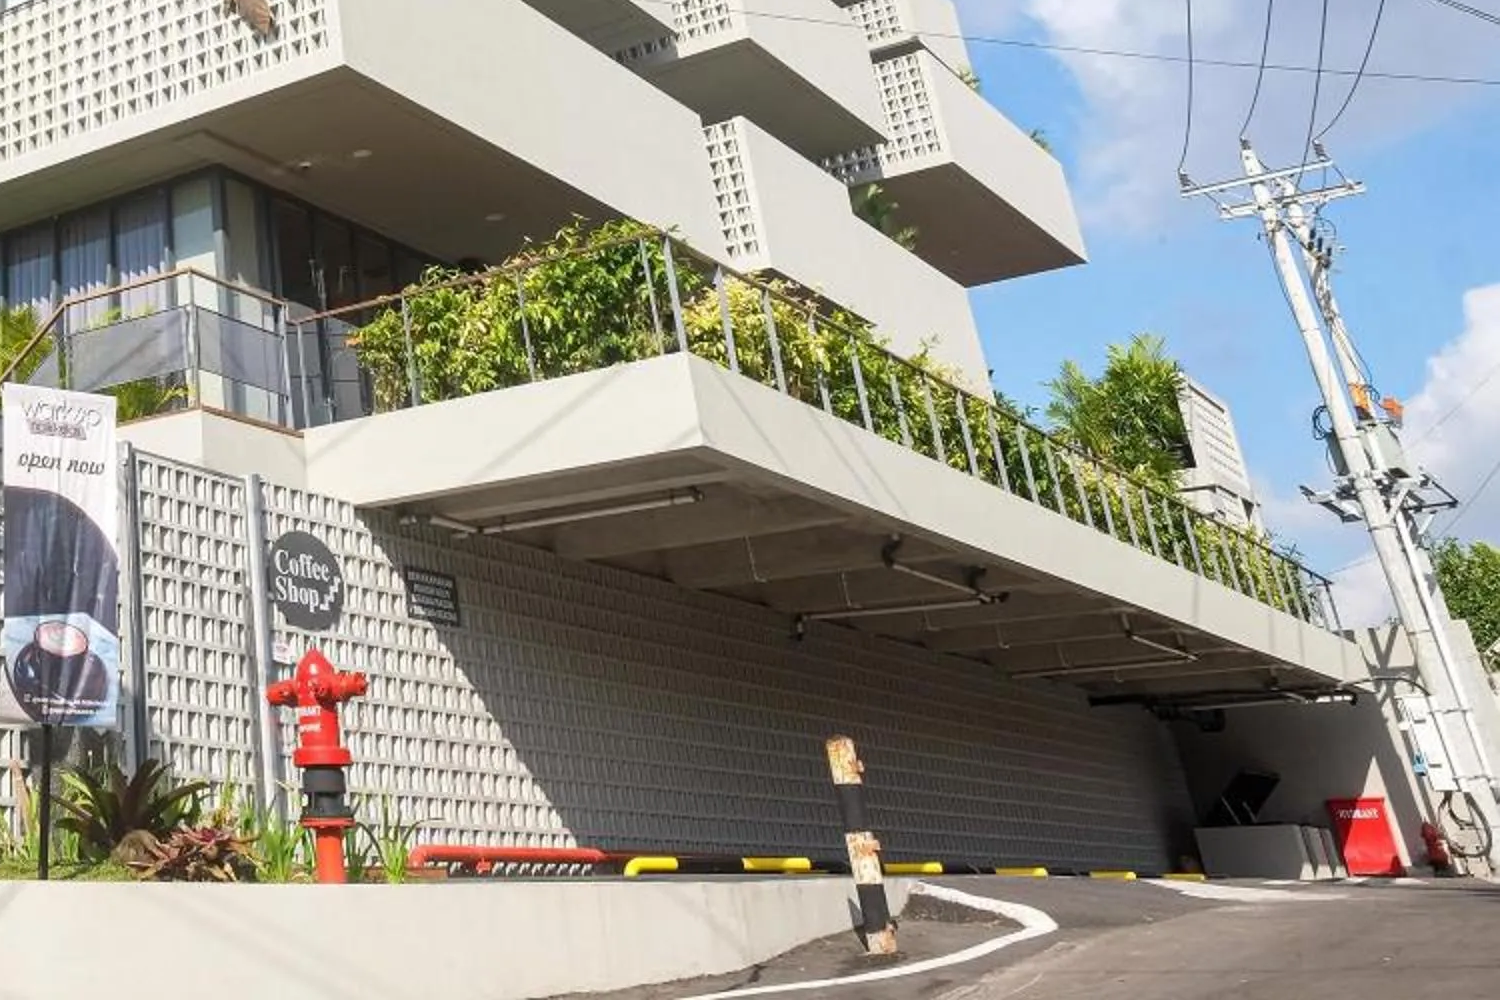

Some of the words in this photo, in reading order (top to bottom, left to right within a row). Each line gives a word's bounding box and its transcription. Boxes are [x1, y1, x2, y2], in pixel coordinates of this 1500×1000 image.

[18, 452, 61, 473] open
[66, 459, 105, 475] now
[274, 549, 330, 582] Coffee
[275, 575, 319, 613] Shop
